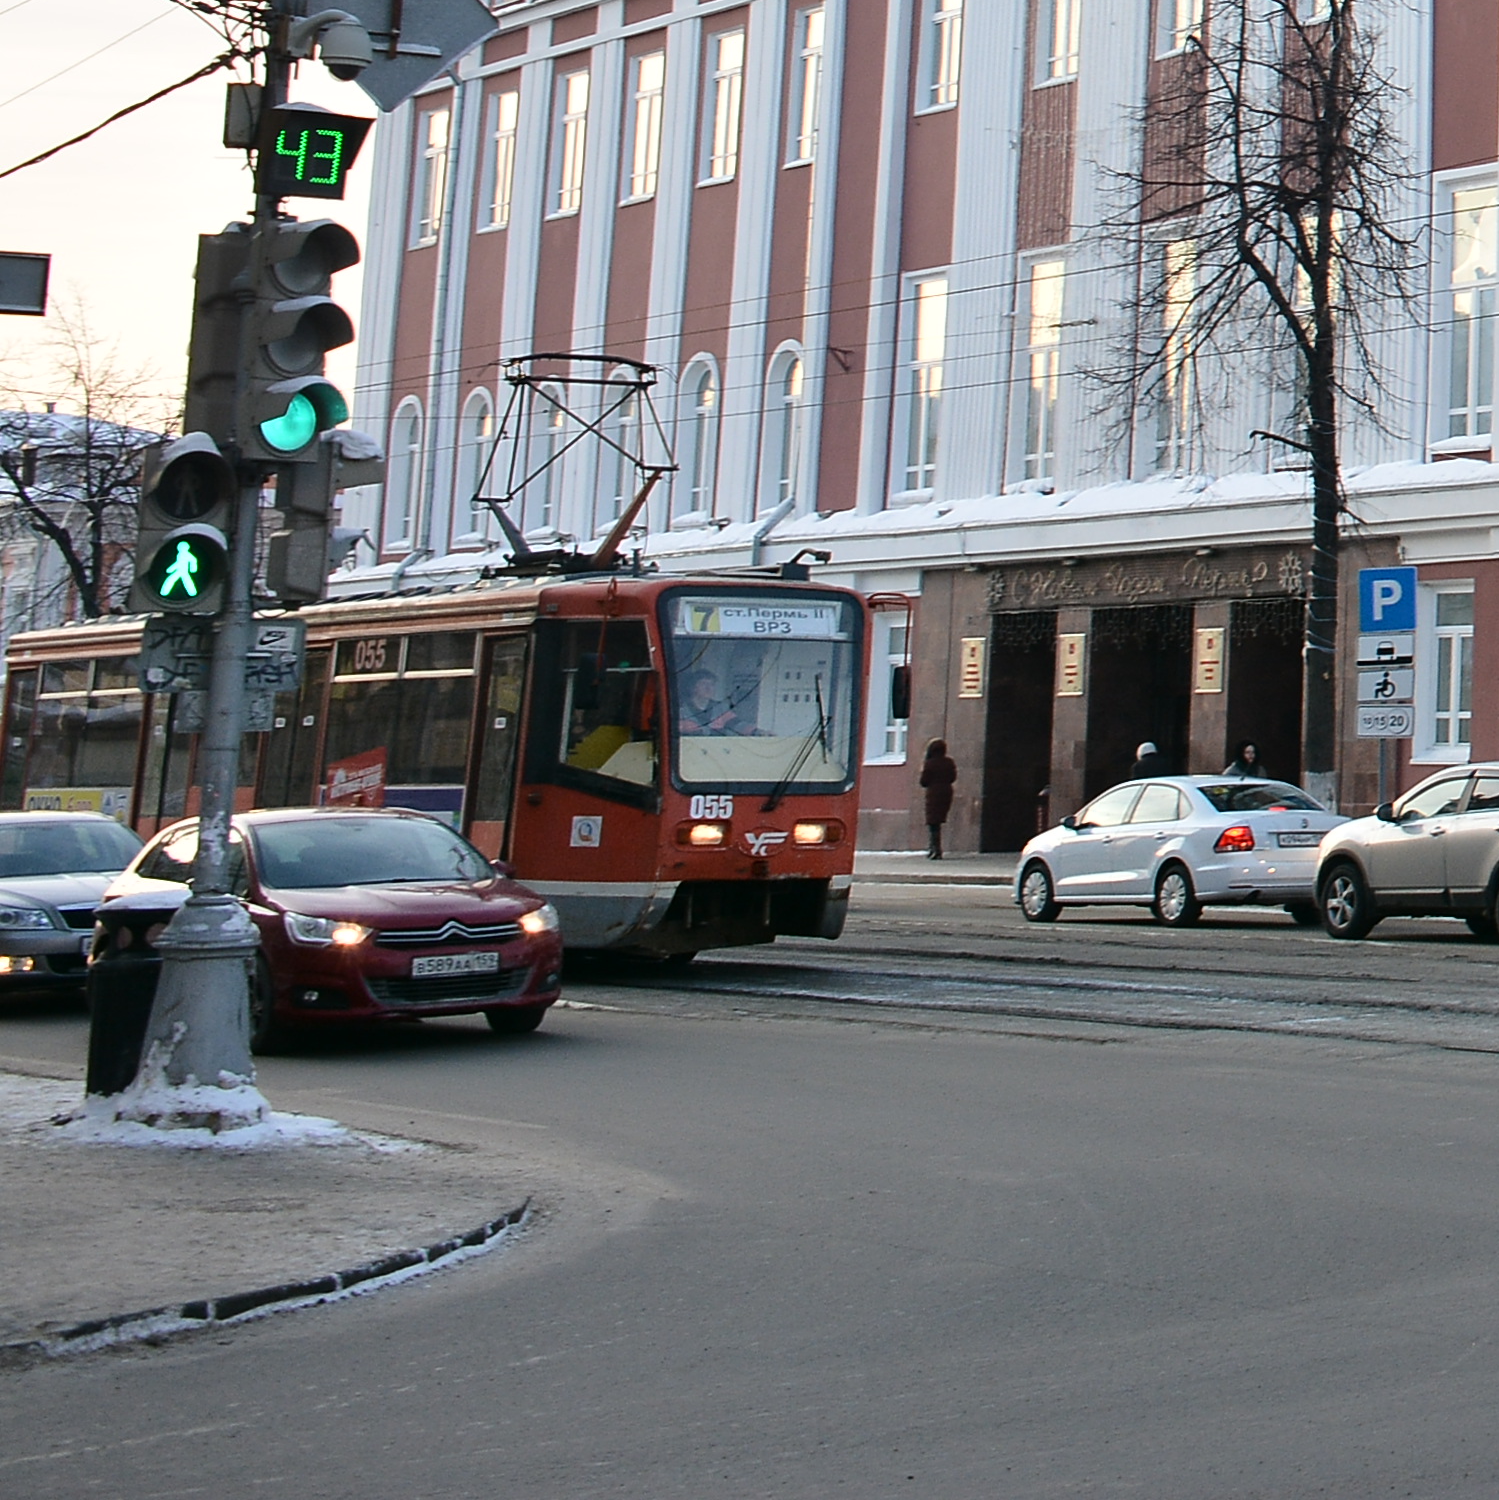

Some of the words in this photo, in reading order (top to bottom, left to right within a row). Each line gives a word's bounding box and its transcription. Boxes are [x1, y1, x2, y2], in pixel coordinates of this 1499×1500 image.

[275, 129, 343, 184] 43
[694, 606, 716, 632] 7
[753, 621, 792, 634] ВРЗ
[354, 638, 387, 670] 055
[1374, 715, 1386, 726] 15
[1389, 715, 1405, 727] 20
[690, 795, 733, 819] 055
